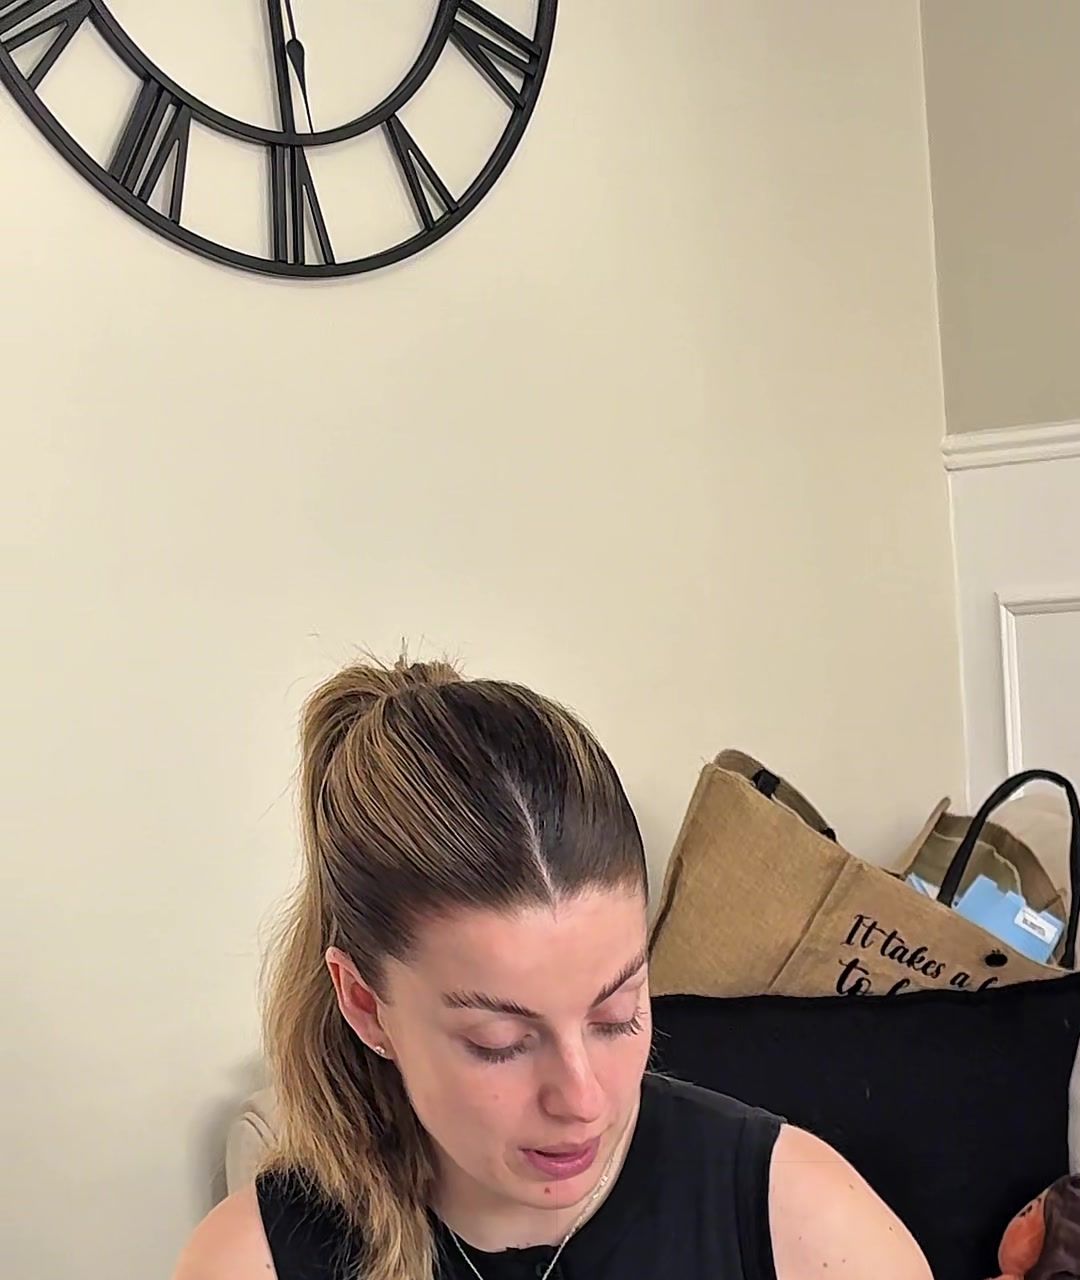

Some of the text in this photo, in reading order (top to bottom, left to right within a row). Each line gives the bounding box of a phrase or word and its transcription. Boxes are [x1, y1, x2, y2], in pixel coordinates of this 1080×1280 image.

[836, 957, 874, 996] to
[841, 914, 887, 949] It
[880, 929, 946, 979] takes
[950, 971, 970, 988] a
